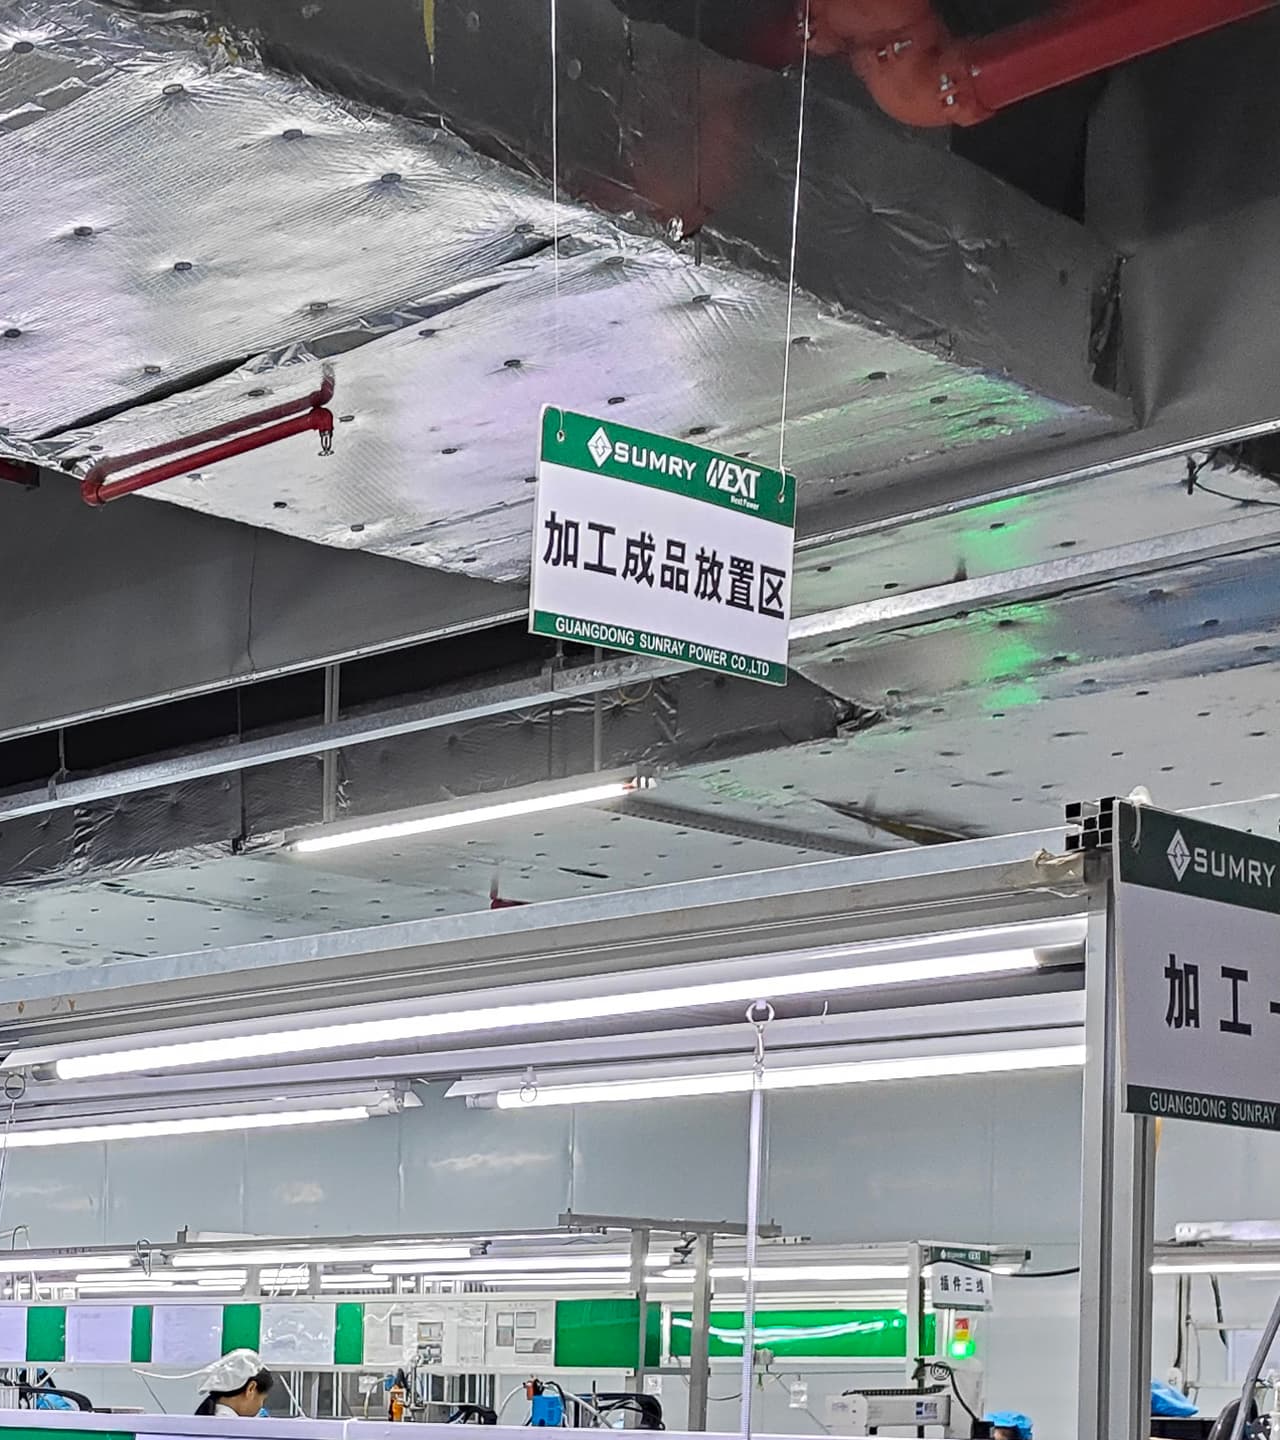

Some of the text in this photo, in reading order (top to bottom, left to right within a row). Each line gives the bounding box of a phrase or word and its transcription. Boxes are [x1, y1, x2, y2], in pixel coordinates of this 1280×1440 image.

[613, 440, 697, 481] SUMRY
[543, 511, 786, 620] 加工成品放置区
[555, 616, 770, 677] GUANGDONG SUNRAY POWER CO.,LTD
[1194, 847, 1276, 888] SUMRY
[1149, 1091, 1276, 1125] GUANGDONG SUNRAY
